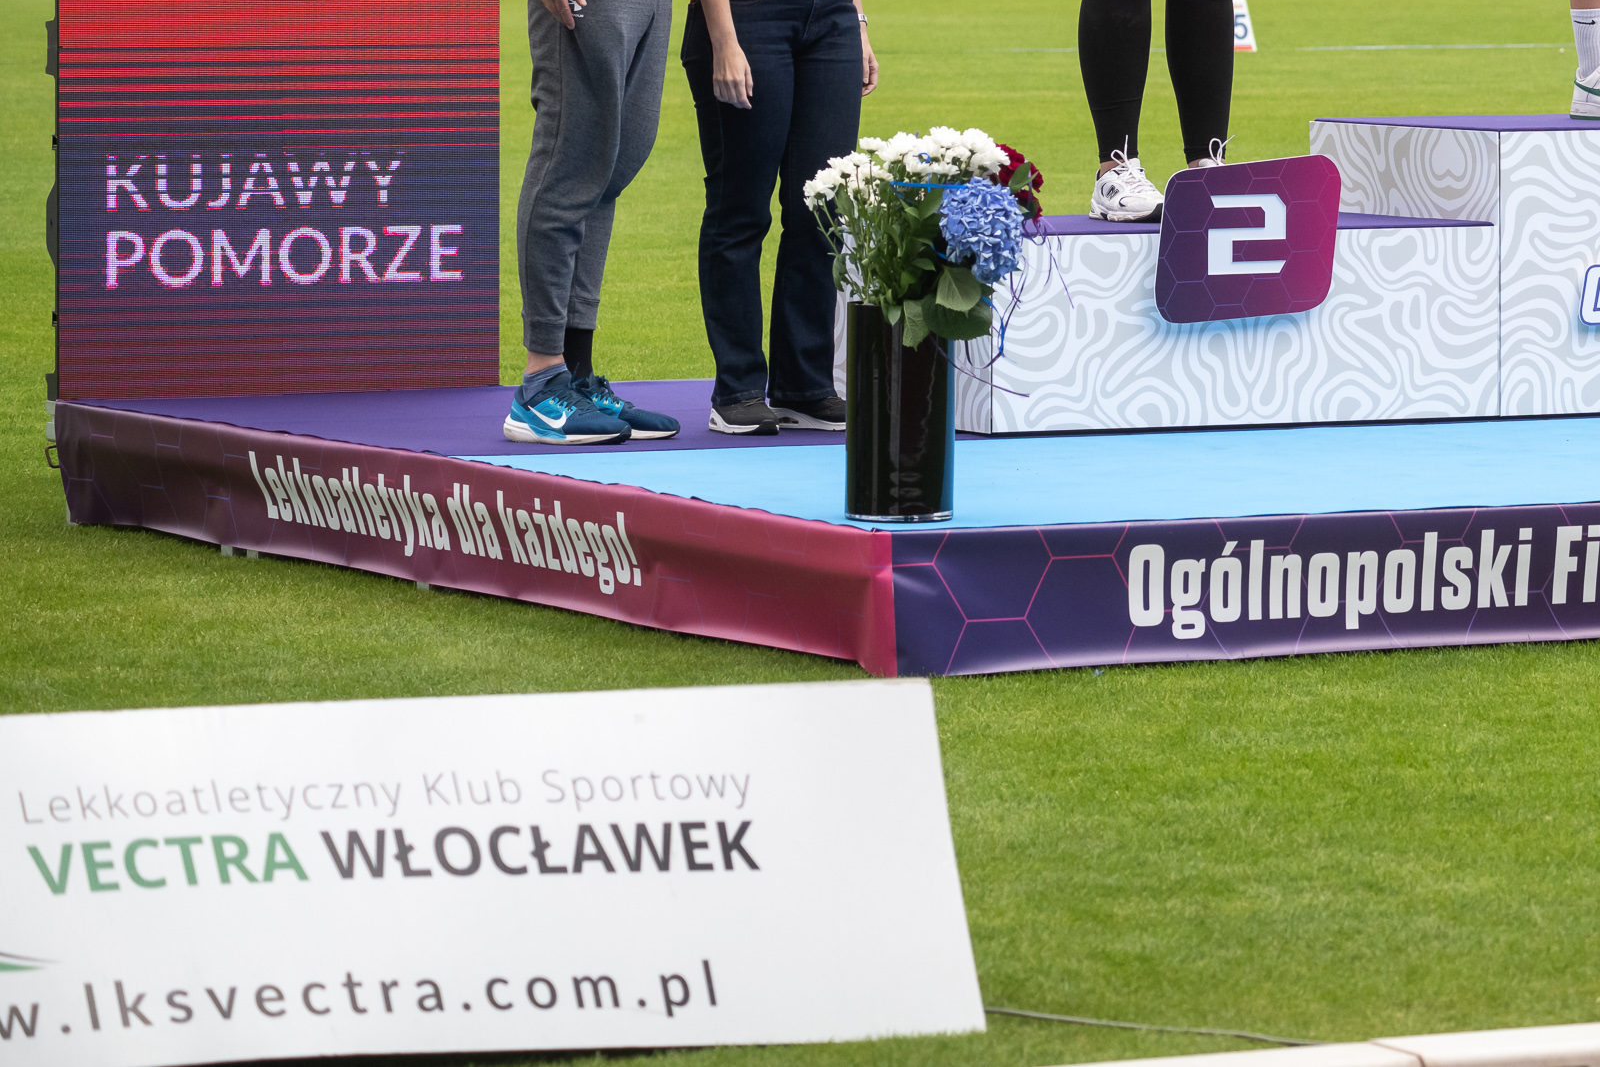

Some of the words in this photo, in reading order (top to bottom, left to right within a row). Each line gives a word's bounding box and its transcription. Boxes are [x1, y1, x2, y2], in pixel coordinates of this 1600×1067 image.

[105, 151, 405, 212] KUJAWY
[105, 223, 464, 289] POMORZE
[1207, 193, 1288, 276] 2
[248, 449, 452, 557] Lekkoatletyka
[446, 482, 502, 561] dla
[496, 489, 643, 595] każdego!
[1128, 527, 1533, 640] Ogólnopolski
[18, 778, 403, 826] Lekkoatletyczny
[422, 768, 523, 807] Klub
[540, 766, 752, 813] Sportowy
[27, 831, 310, 896] VECTRA
[320, 819, 761, 881] WŁOCŁAWEK
